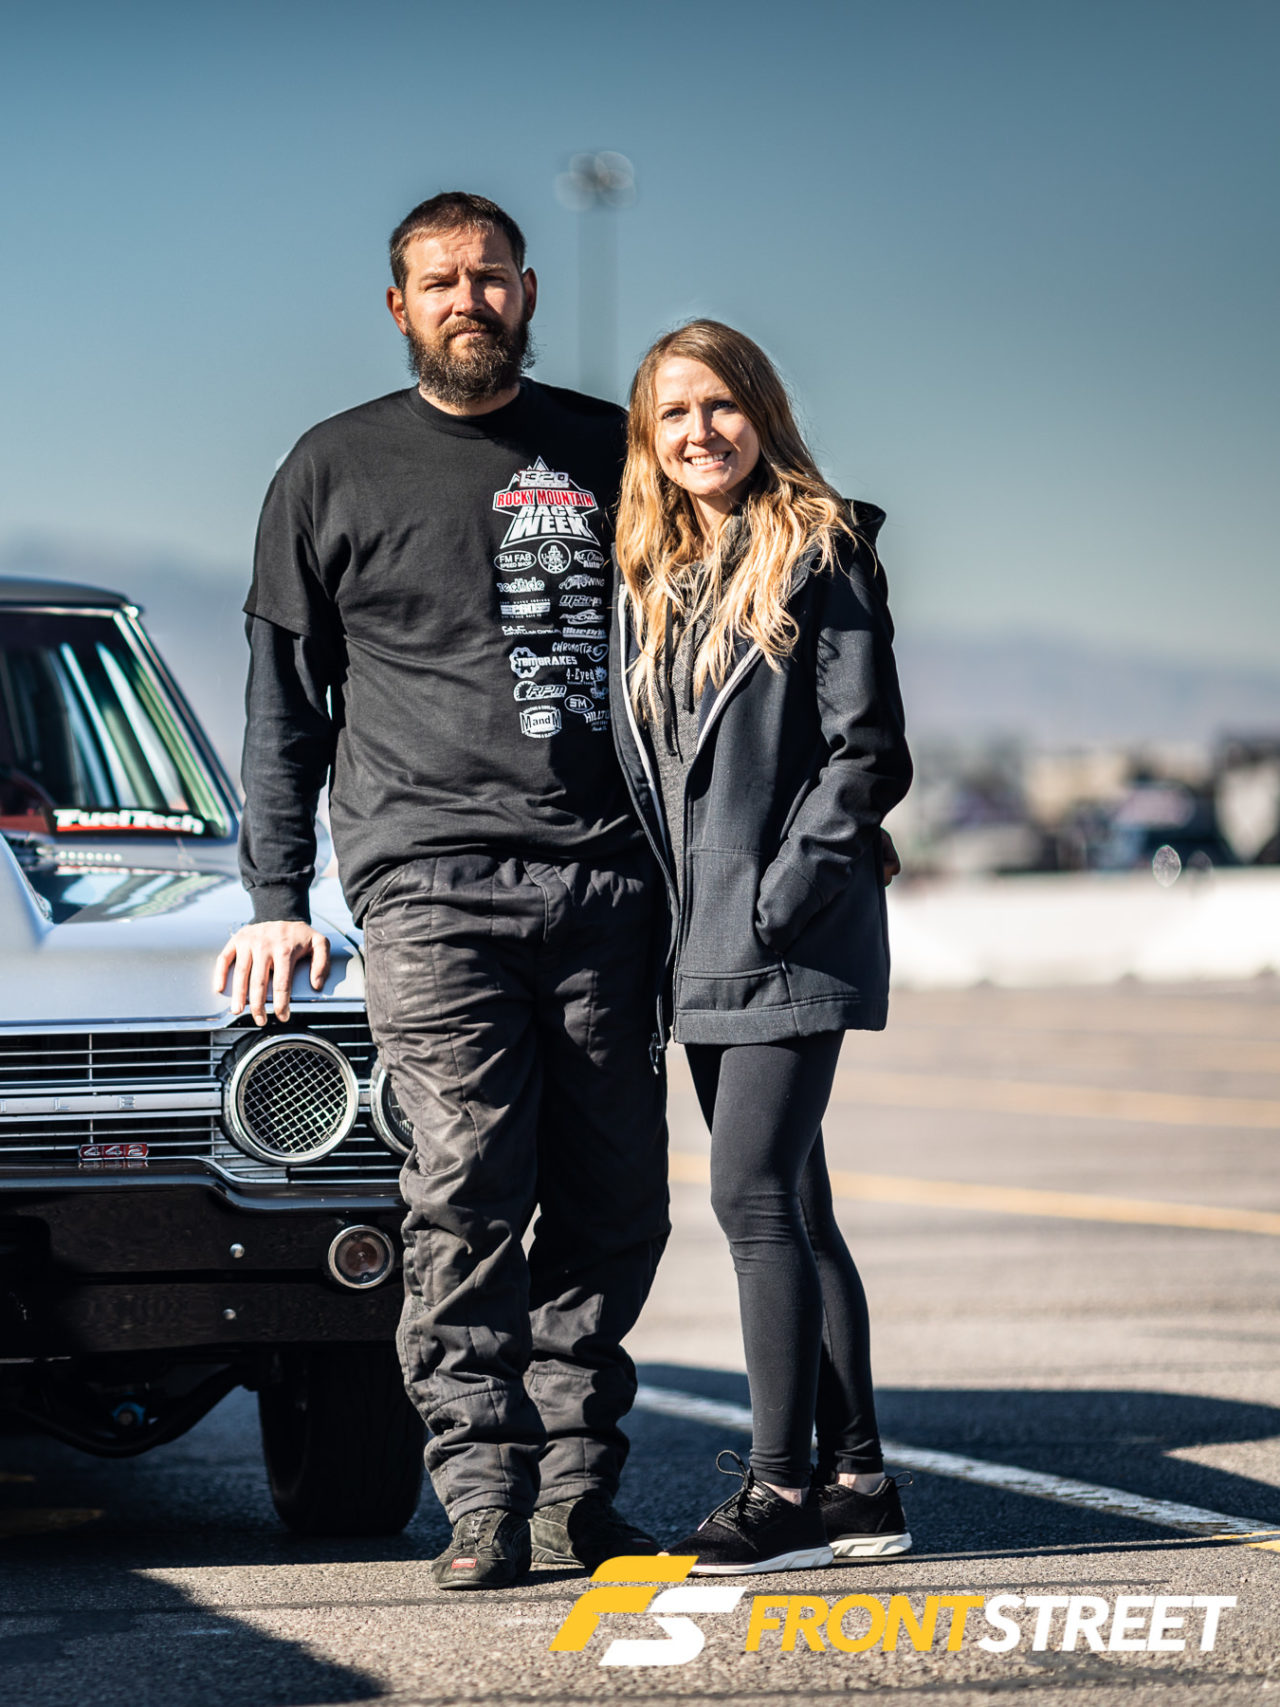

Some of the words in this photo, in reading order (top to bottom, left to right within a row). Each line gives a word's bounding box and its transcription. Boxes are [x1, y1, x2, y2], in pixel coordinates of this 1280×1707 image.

[519, 470, 569, 483] 1320
[497, 489, 535, 506] ROCKY
[536, 489, 595, 507] MOUNTAIN
[518, 505, 581, 517] RACE
[508, 516, 593, 541] WEEK
[500, 555, 514, 563] FM
[515, 553, 532, 561] FAB
[566, 668, 595, 683] 4-Eyed
[532, 715, 551, 727] and
[53, 809, 205, 835] FuelTech
[82, 1144, 147, 1159] 442
